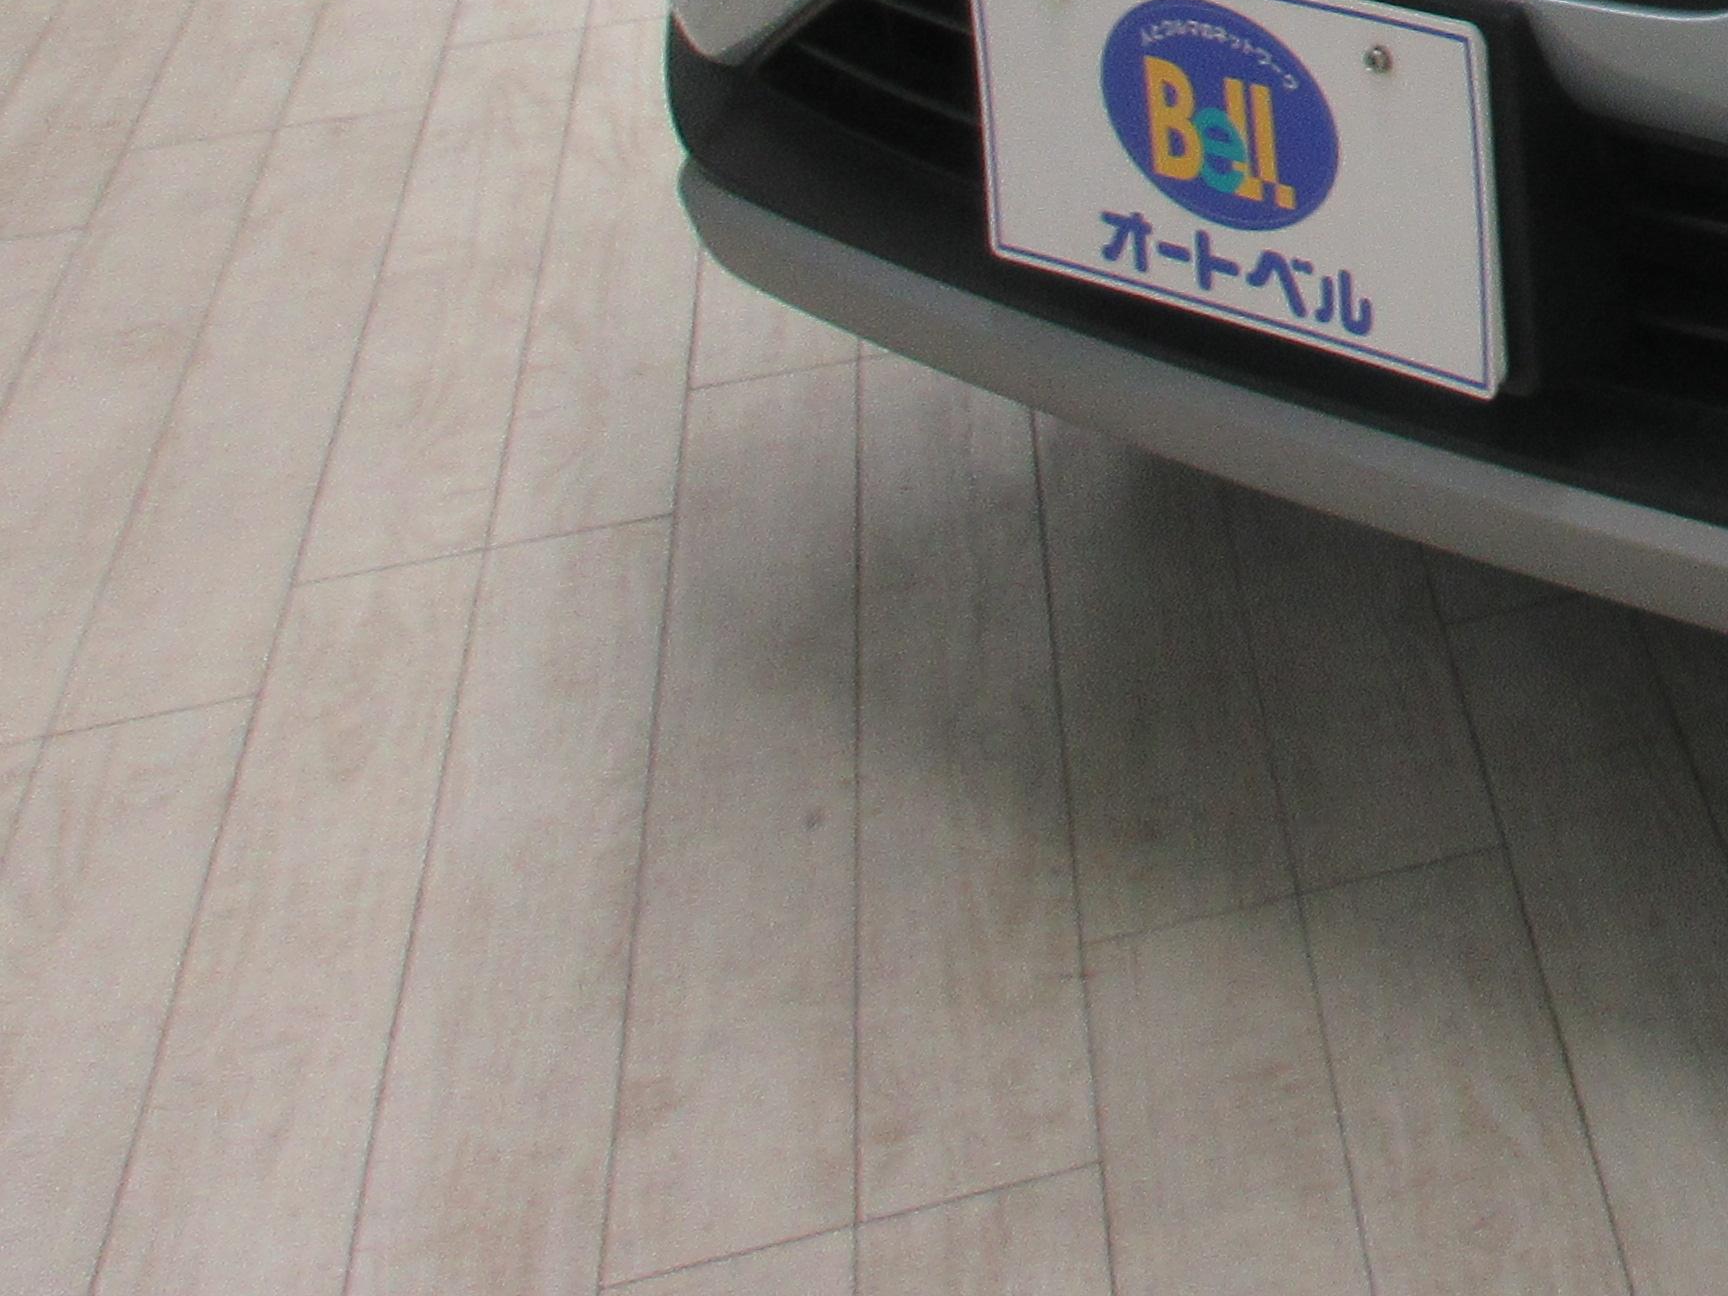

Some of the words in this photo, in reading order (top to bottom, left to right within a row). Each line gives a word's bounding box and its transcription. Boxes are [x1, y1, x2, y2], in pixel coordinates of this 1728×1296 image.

[1100, 211, 1374, 338] オートベル
